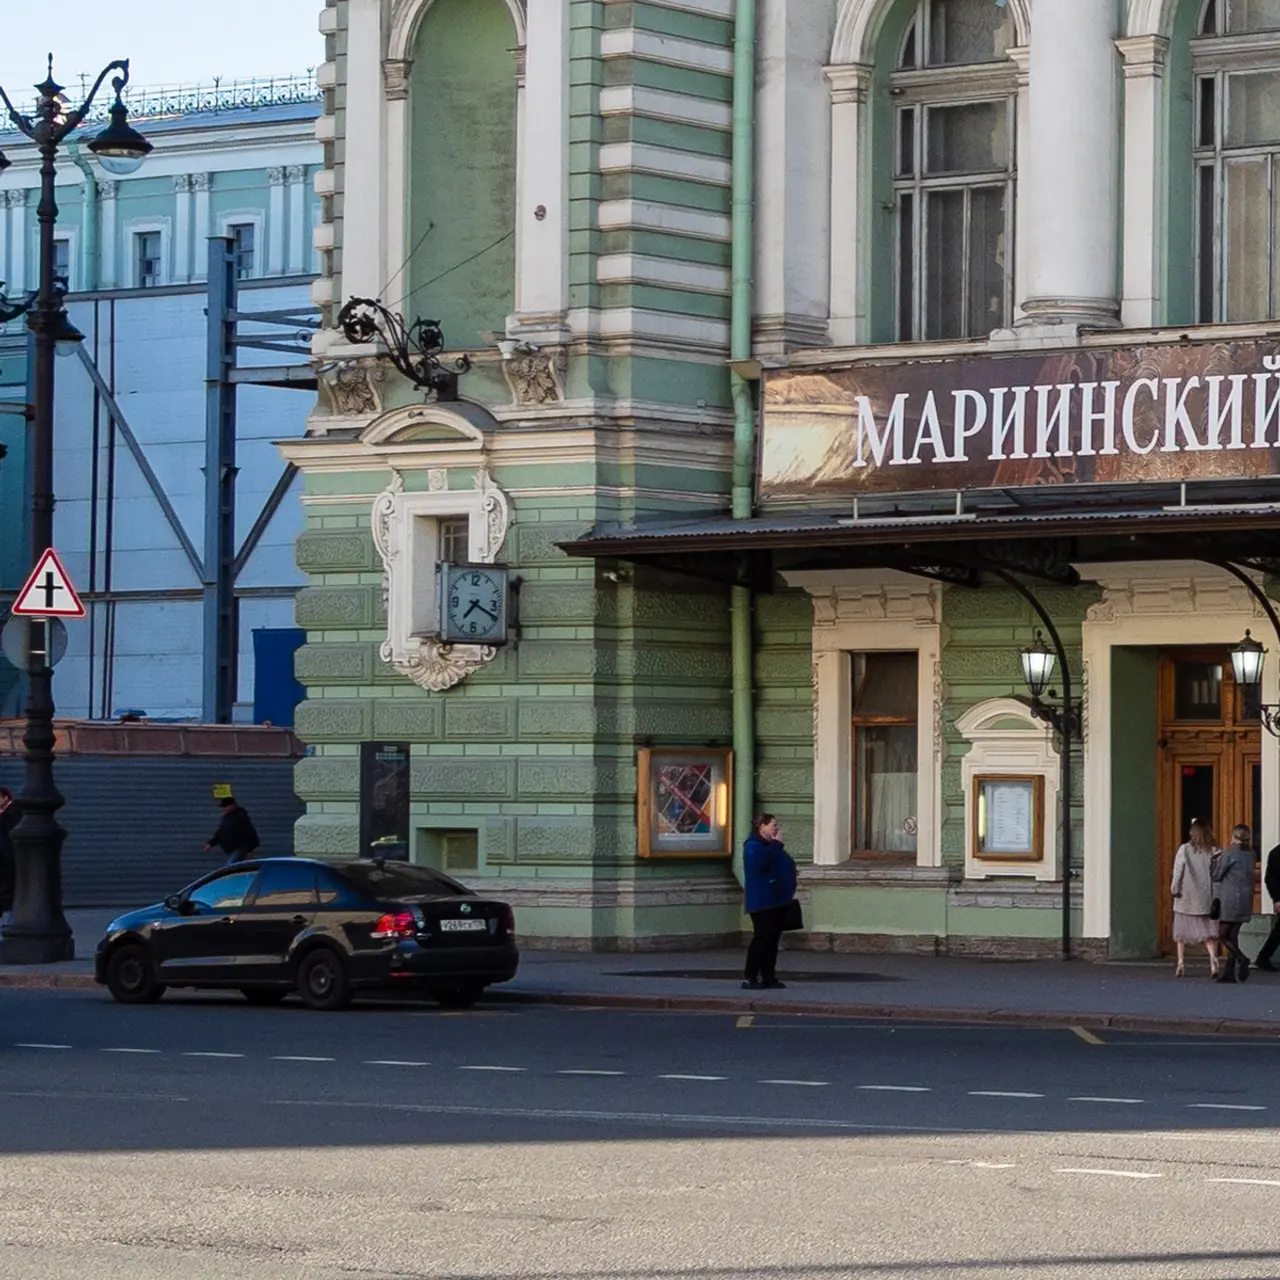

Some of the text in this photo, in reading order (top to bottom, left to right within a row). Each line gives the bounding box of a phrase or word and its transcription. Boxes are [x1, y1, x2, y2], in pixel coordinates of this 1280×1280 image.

[471, 575, 480, 587] 12
[452, 596, 459, 608] 9
[490, 600, 498, 612] 3
[470, 621, 477, 633] 6
